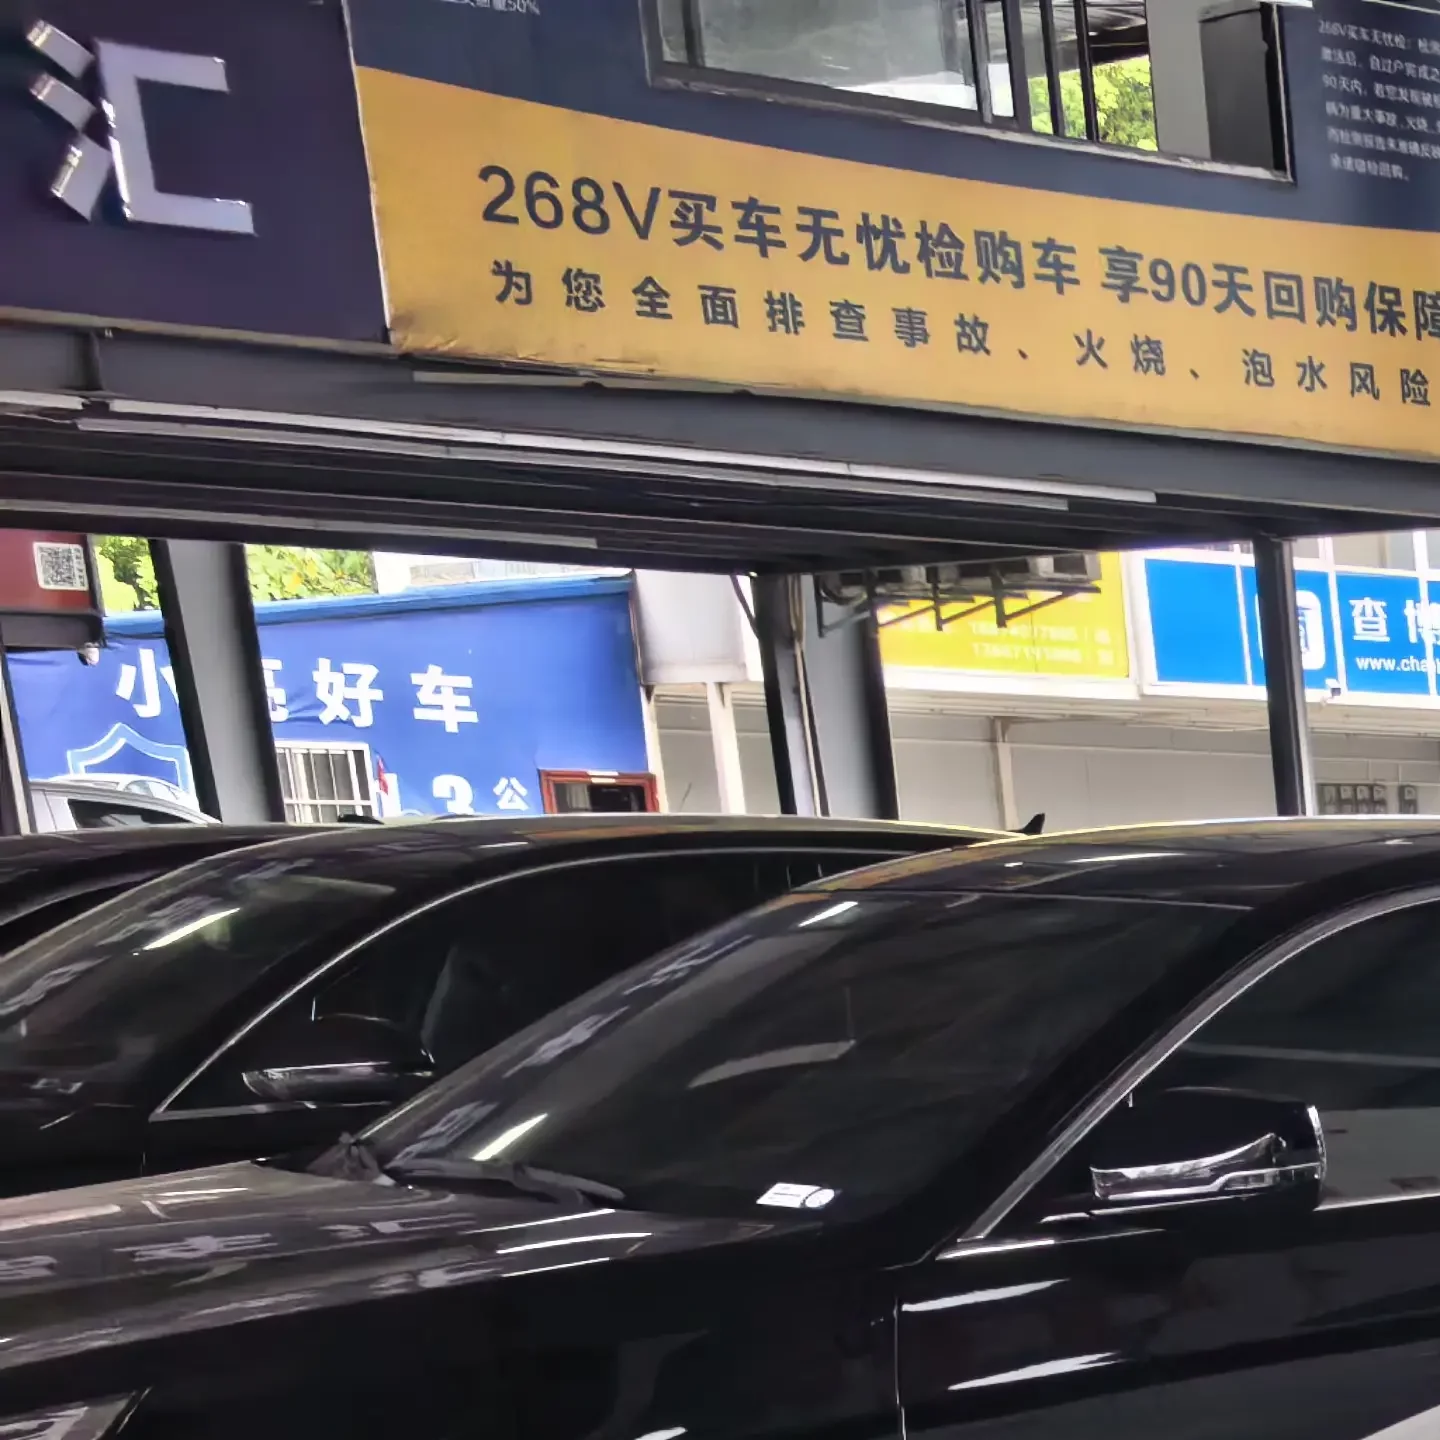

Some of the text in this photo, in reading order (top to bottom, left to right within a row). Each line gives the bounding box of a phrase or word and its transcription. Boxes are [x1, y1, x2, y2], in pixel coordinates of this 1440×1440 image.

[26, 17, 259, 237] 汇
[478, 165, 1080, 296] 268V买车无忧检购车
